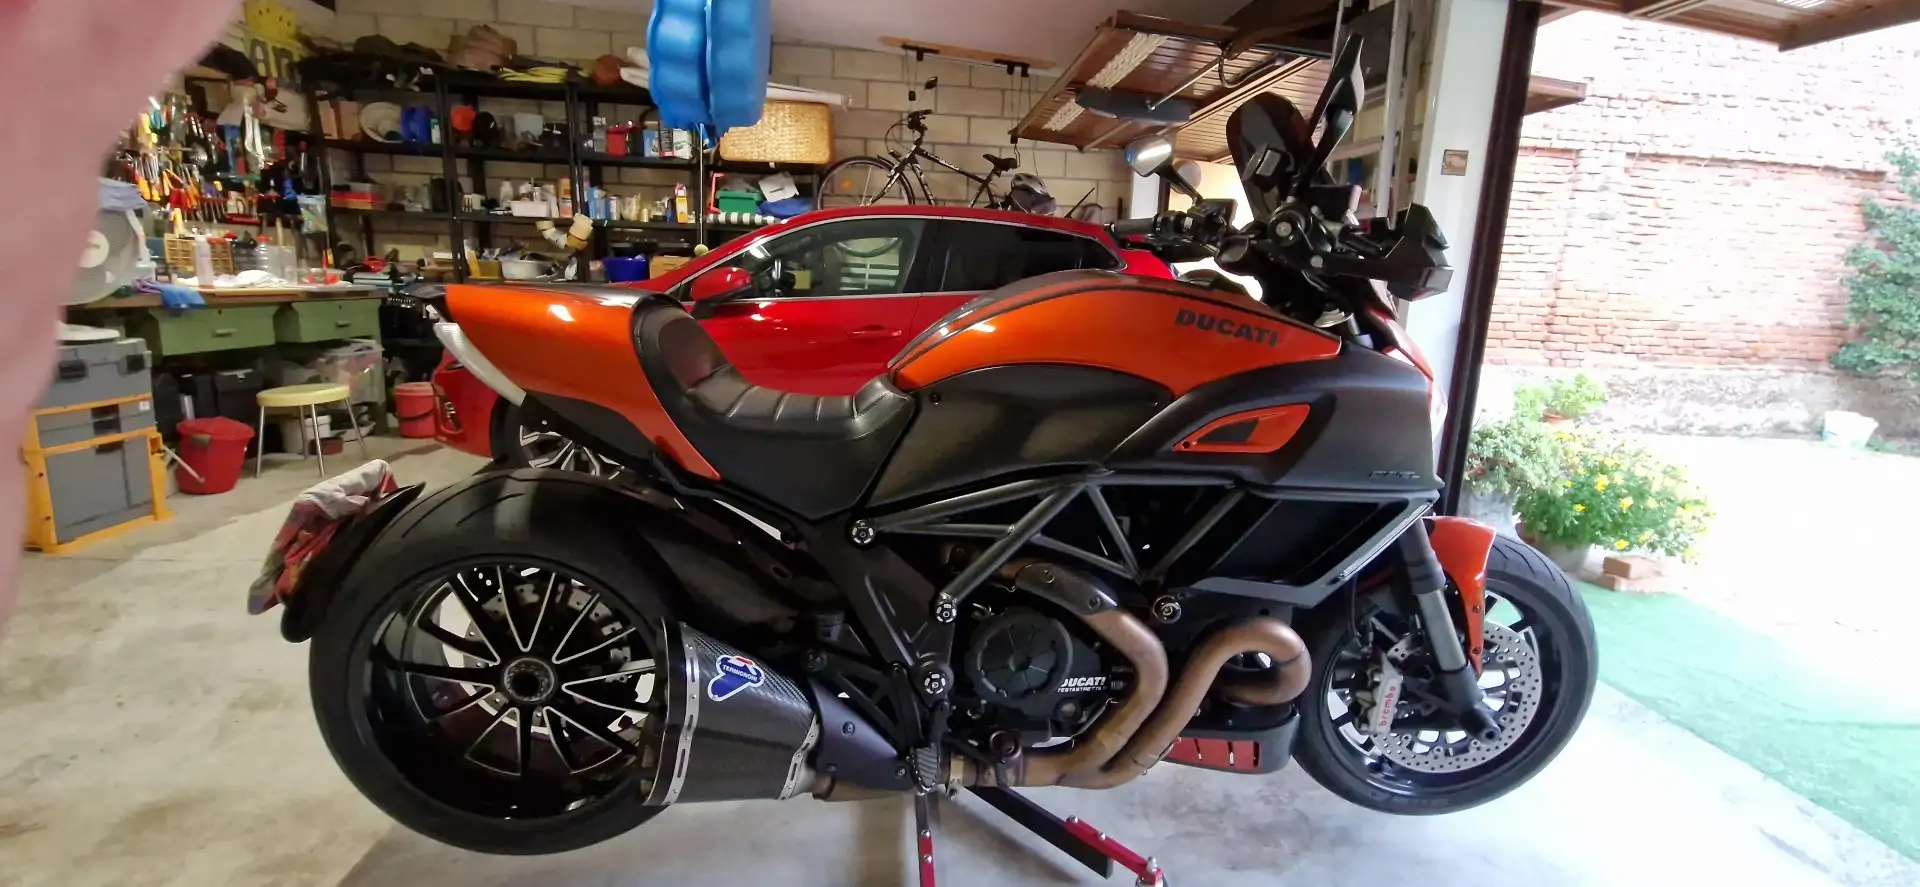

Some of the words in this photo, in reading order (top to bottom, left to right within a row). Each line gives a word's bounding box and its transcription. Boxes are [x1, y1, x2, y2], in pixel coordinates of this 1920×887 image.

[1174, 308, 1278, 347] DUCATI
[1059, 677, 1107, 688] DUCATI
[1378, 686, 1396, 727] brembo
